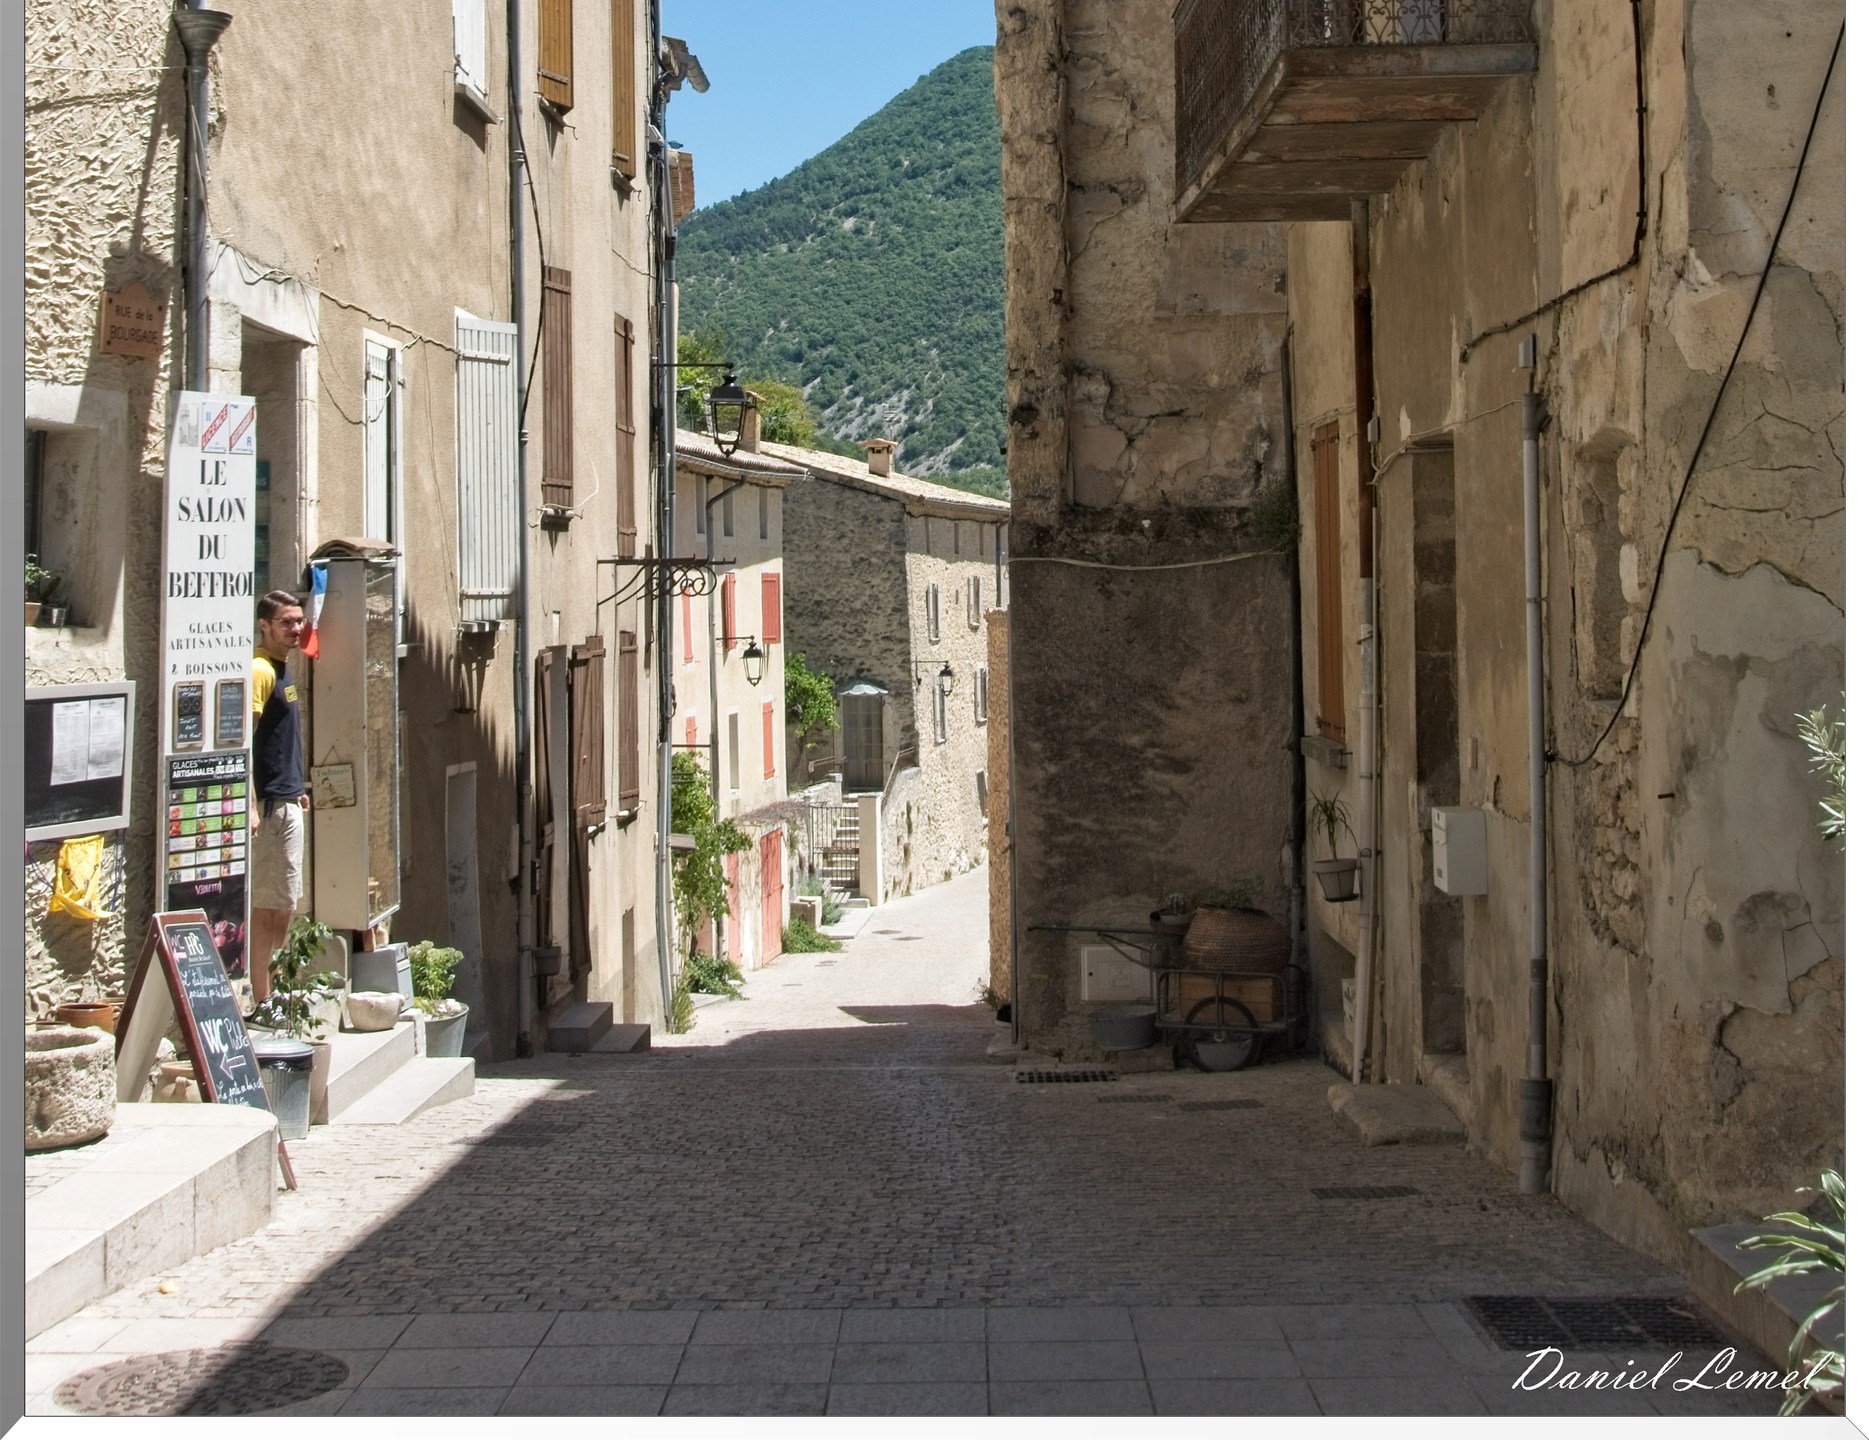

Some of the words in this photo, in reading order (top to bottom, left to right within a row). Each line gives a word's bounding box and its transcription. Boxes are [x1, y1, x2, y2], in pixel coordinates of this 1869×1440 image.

[115, 305, 132, 318] RUE
[135, 309, 144, 320] de
[146, 311, 153, 320] la
[109, 325, 159, 345] BOURGADE
[200, 459, 227, 486] LE
[177, 496, 247, 522] SALON
[198, 534, 228, 560] DU
[168, 571, 255, 598] BEFFROI
[189, 621, 233, 635] GLACES
[168, 635, 252, 651] ARTISANALES
[185, 661, 243, 675] BOISSONS
[172, 760, 198, 770] GLACES
[172, 767, 215, 779] ARTISANALES
[200, 1018, 229, 1054] WC
